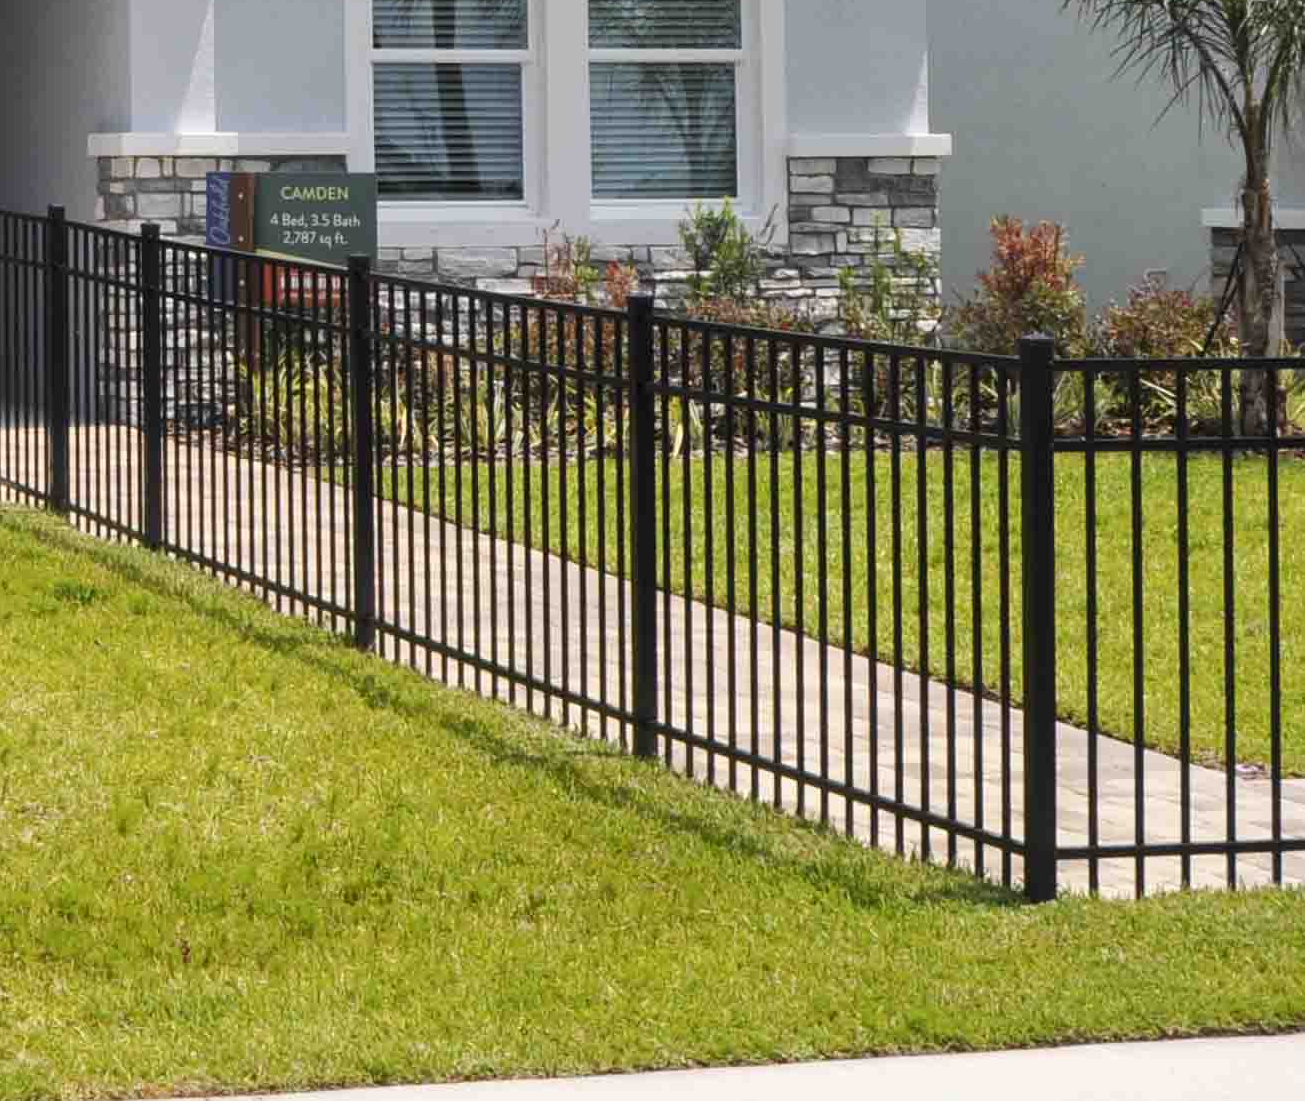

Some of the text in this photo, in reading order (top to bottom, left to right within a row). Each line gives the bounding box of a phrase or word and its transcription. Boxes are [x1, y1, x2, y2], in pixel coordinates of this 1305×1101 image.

[280, 186, 349, 201] CAMDEN
[269, 212, 361, 228] 4 Bed, 3.5 Bath
[282, 230, 317, 245] 2,787
[319, 233, 332, 249] sq
